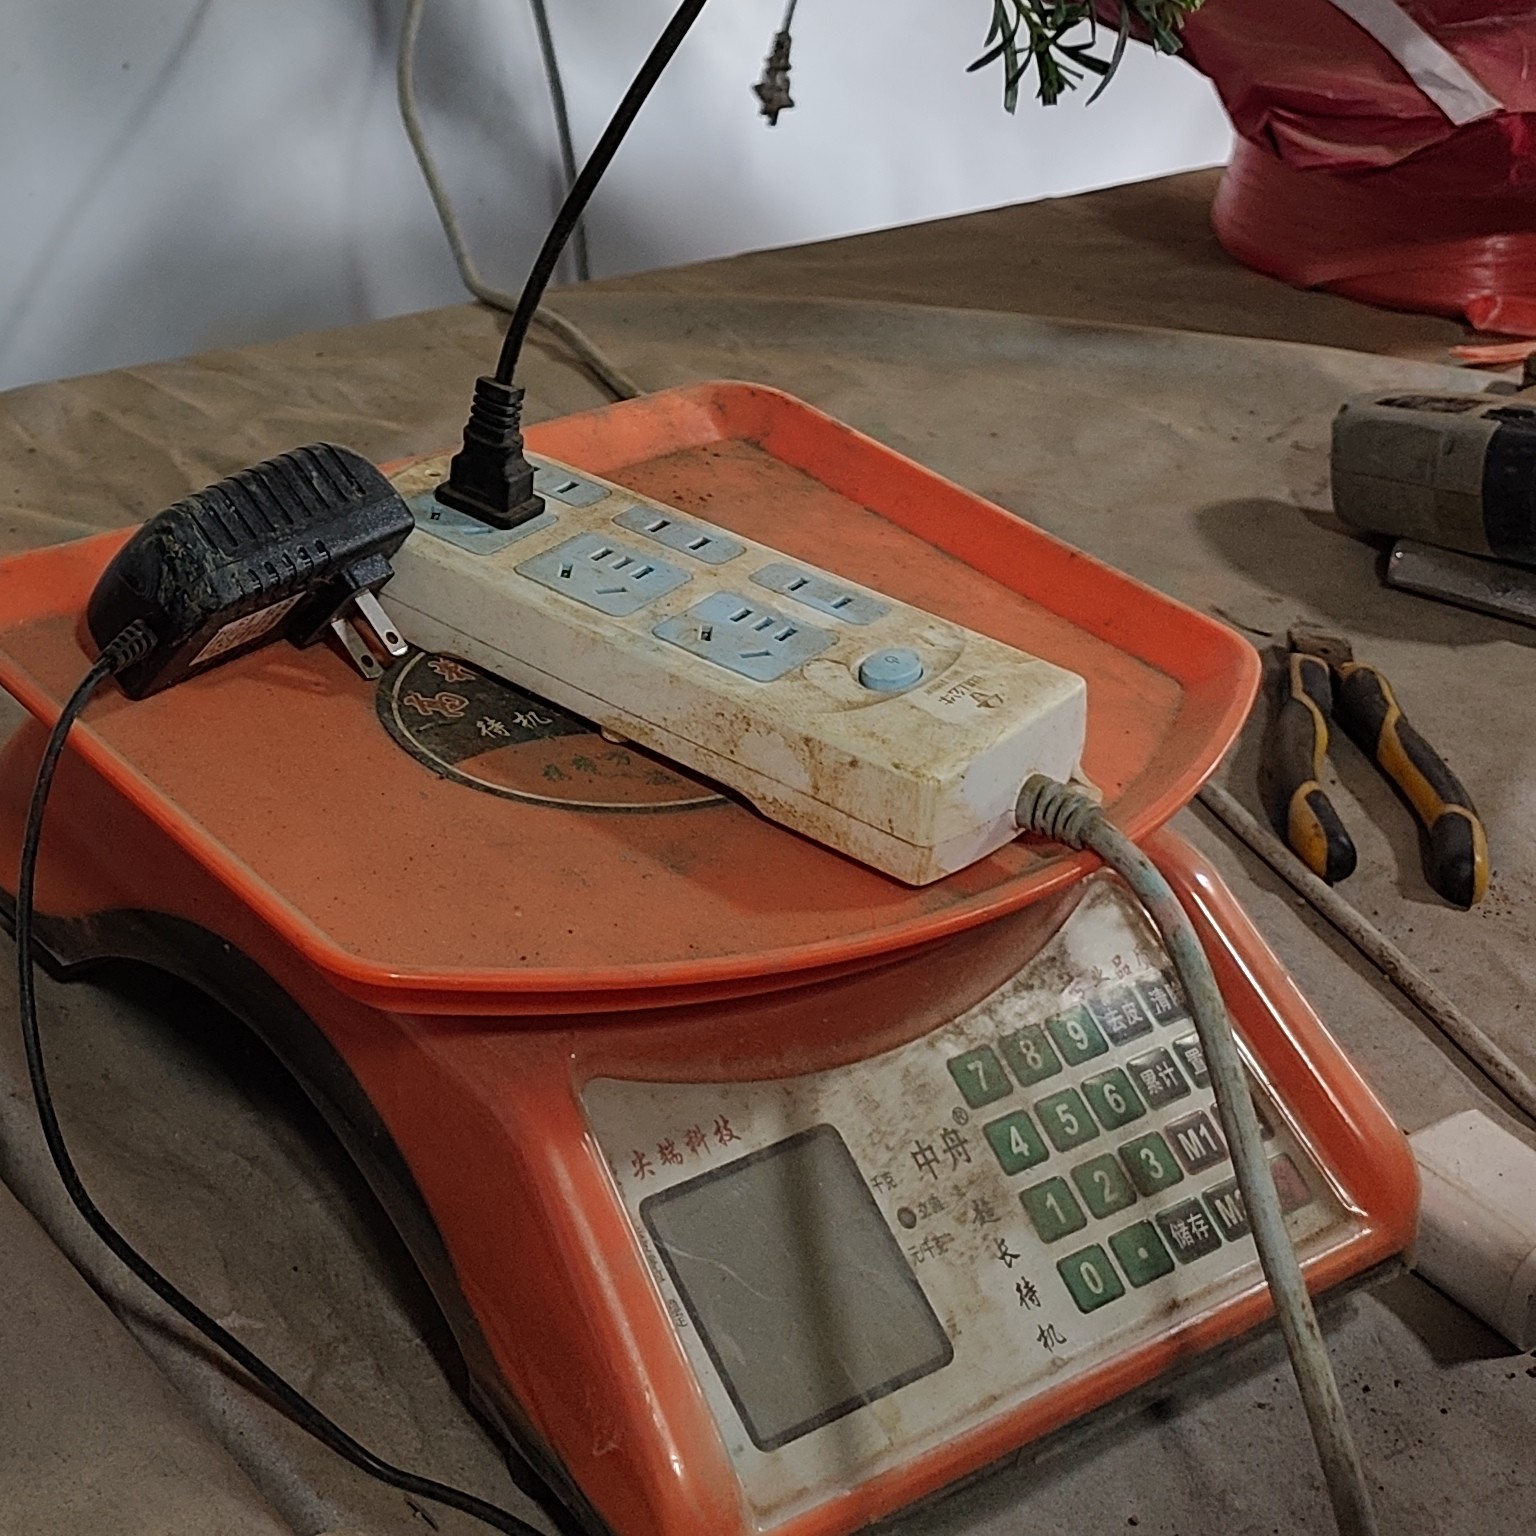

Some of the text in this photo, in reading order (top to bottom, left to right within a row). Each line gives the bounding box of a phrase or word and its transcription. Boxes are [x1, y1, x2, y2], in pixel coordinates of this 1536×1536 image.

[1104, 1001, 1144, 1033] 去皮
[1066, 1019, 1089, 1051] 9
[1019, 1039, 1043, 1070] 8
[966, 1060, 988, 1092] 7
[1139, 1063, 1179, 1096] 累计
[1102, 1083, 1126, 1114] 6
[1055, 1103, 1079, 1135] 5
[631, 1114, 742, 1181] 尖端科技
[1010, 1125, 1030, 1157] 4
[1176, 1122, 1219, 1162] M1
[1139, 1147, 1164, 1180] 3
[1093, 1170, 1119, 1204] 2
[1045, 1191, 1067, 1224] 1
[1170, 1212, 1210, 1250] 储存
[1079, 1261, 1104, 1295] 0
